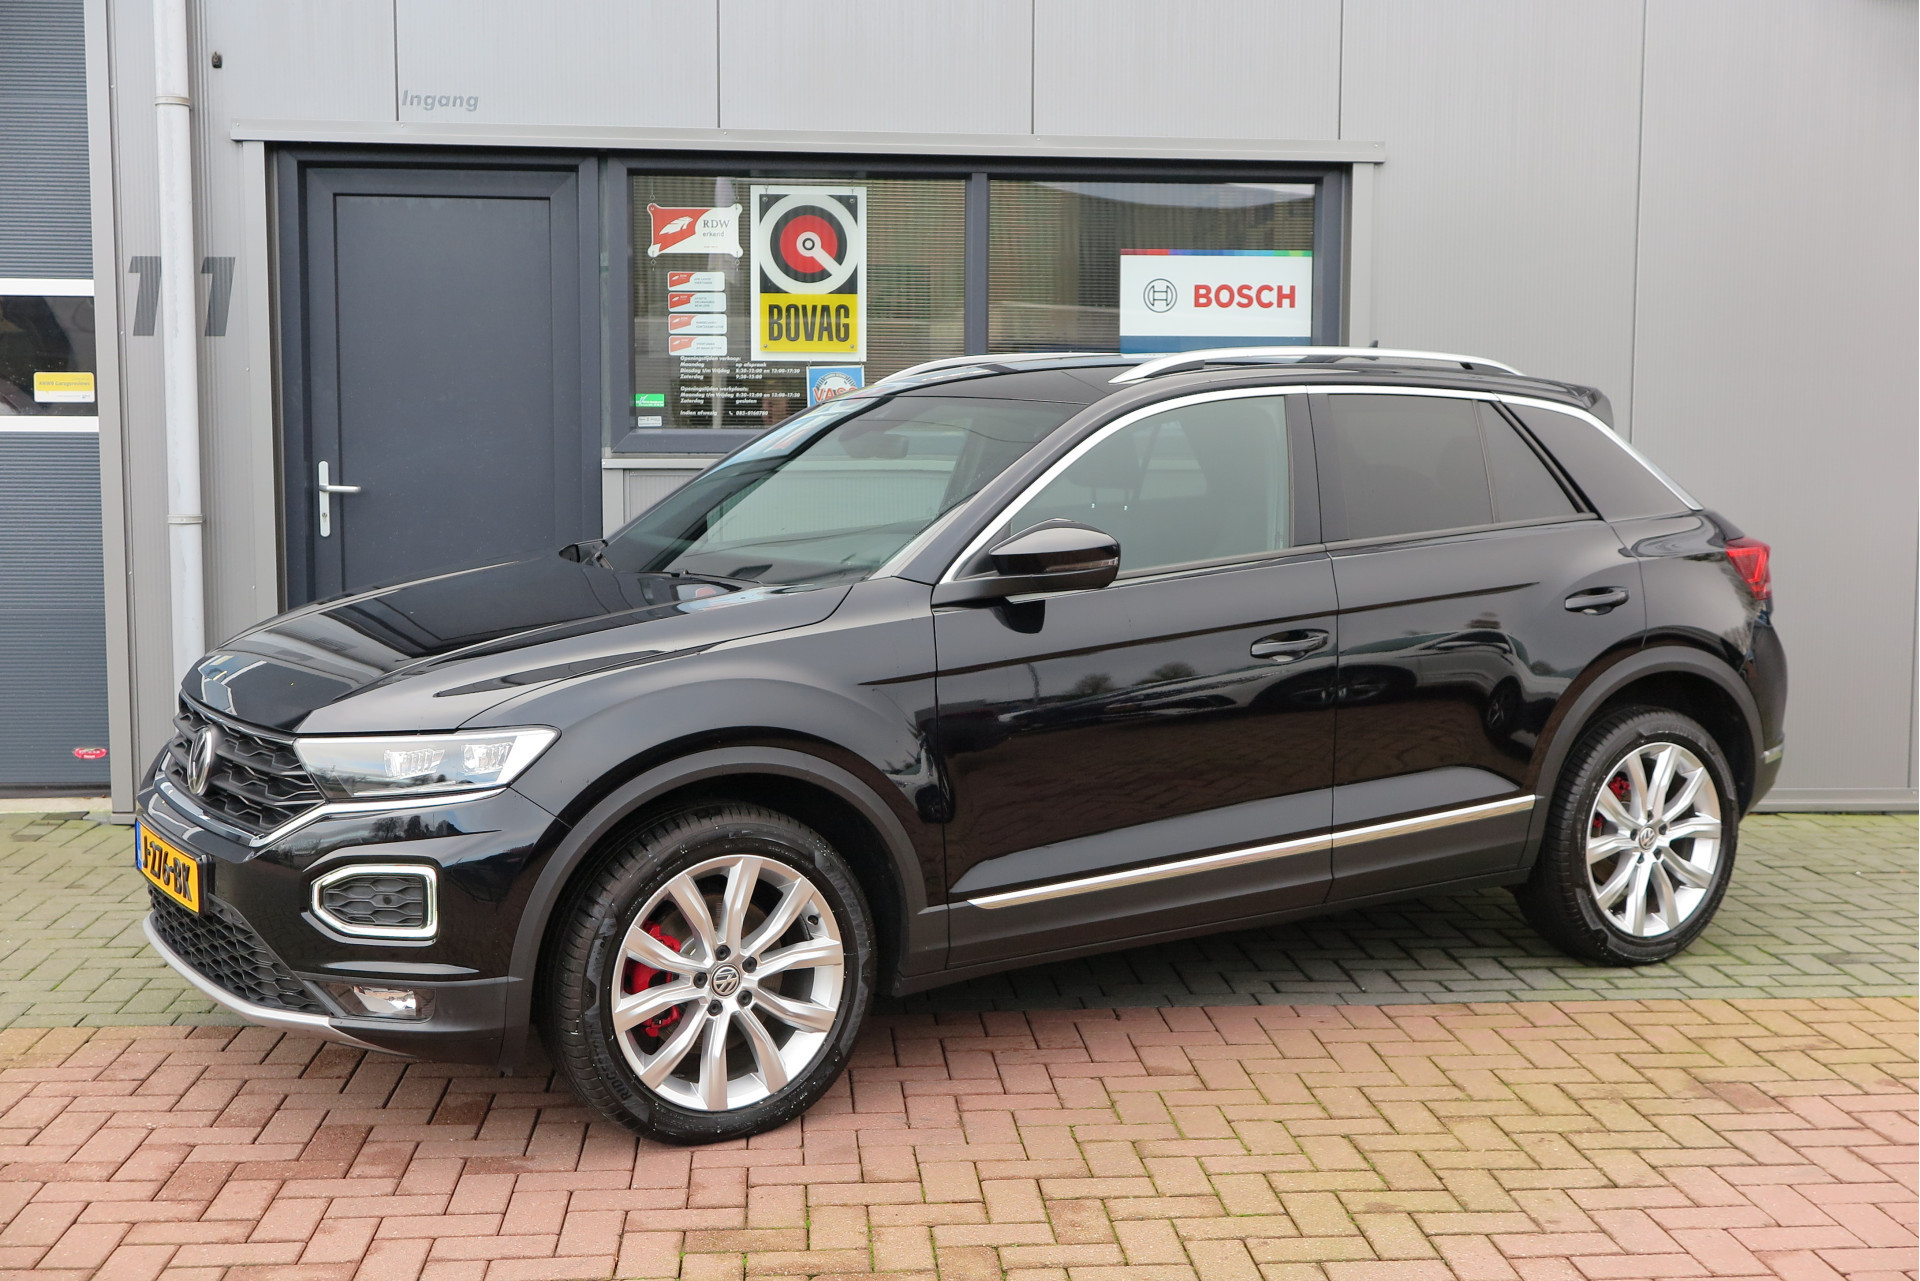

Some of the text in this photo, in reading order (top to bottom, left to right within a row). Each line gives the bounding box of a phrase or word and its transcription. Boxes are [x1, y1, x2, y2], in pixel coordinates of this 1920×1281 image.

[402, 90, 479, 112] Ingang
[703, 220, 730, 229] RDW
[128, 256, 236, 336] 11
[1194, 284, 1296, 308] BOSCH
[768, 304, 850, 342] BOVAG
[813, 386, 858, 402] VAS
[142, 835, 192, 902] J-276-BK
